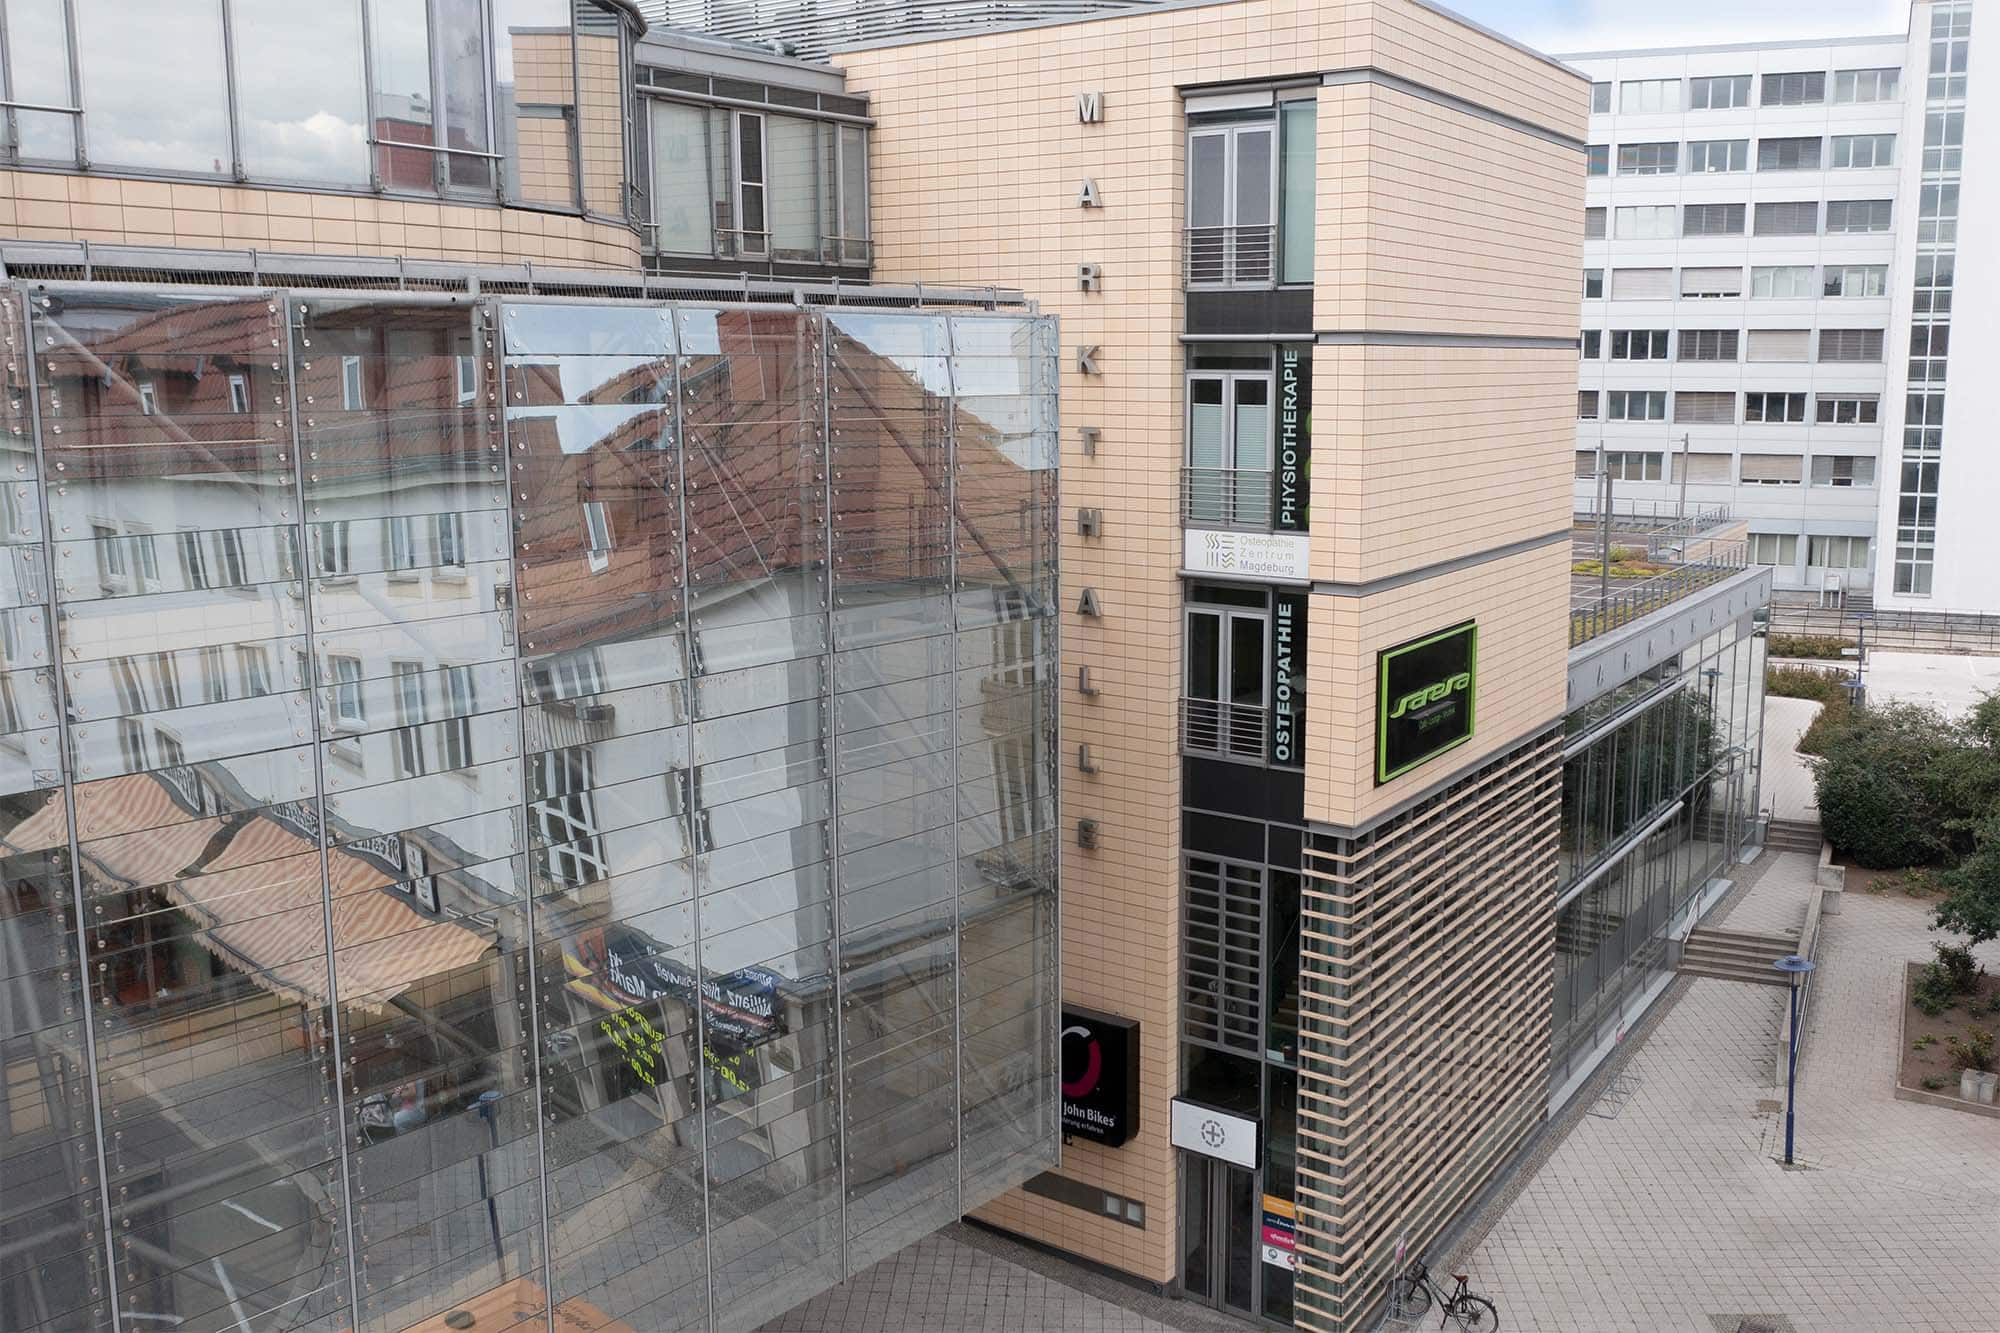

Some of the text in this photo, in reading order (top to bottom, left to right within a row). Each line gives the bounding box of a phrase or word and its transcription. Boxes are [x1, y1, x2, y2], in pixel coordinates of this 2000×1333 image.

[1281, 350, 1298, 524] PHYSIOTHERAPIE
[1240, 535, 1295, 548] Osteopathie
[1240, 547, 1294, 561] Zentrum
[1240, 560, 1295, 576] Magdeburg
[1276, 603, 1292, 761] OSTEOPATHIE
[1063, 1101, 1115, 1127] John Bikes
